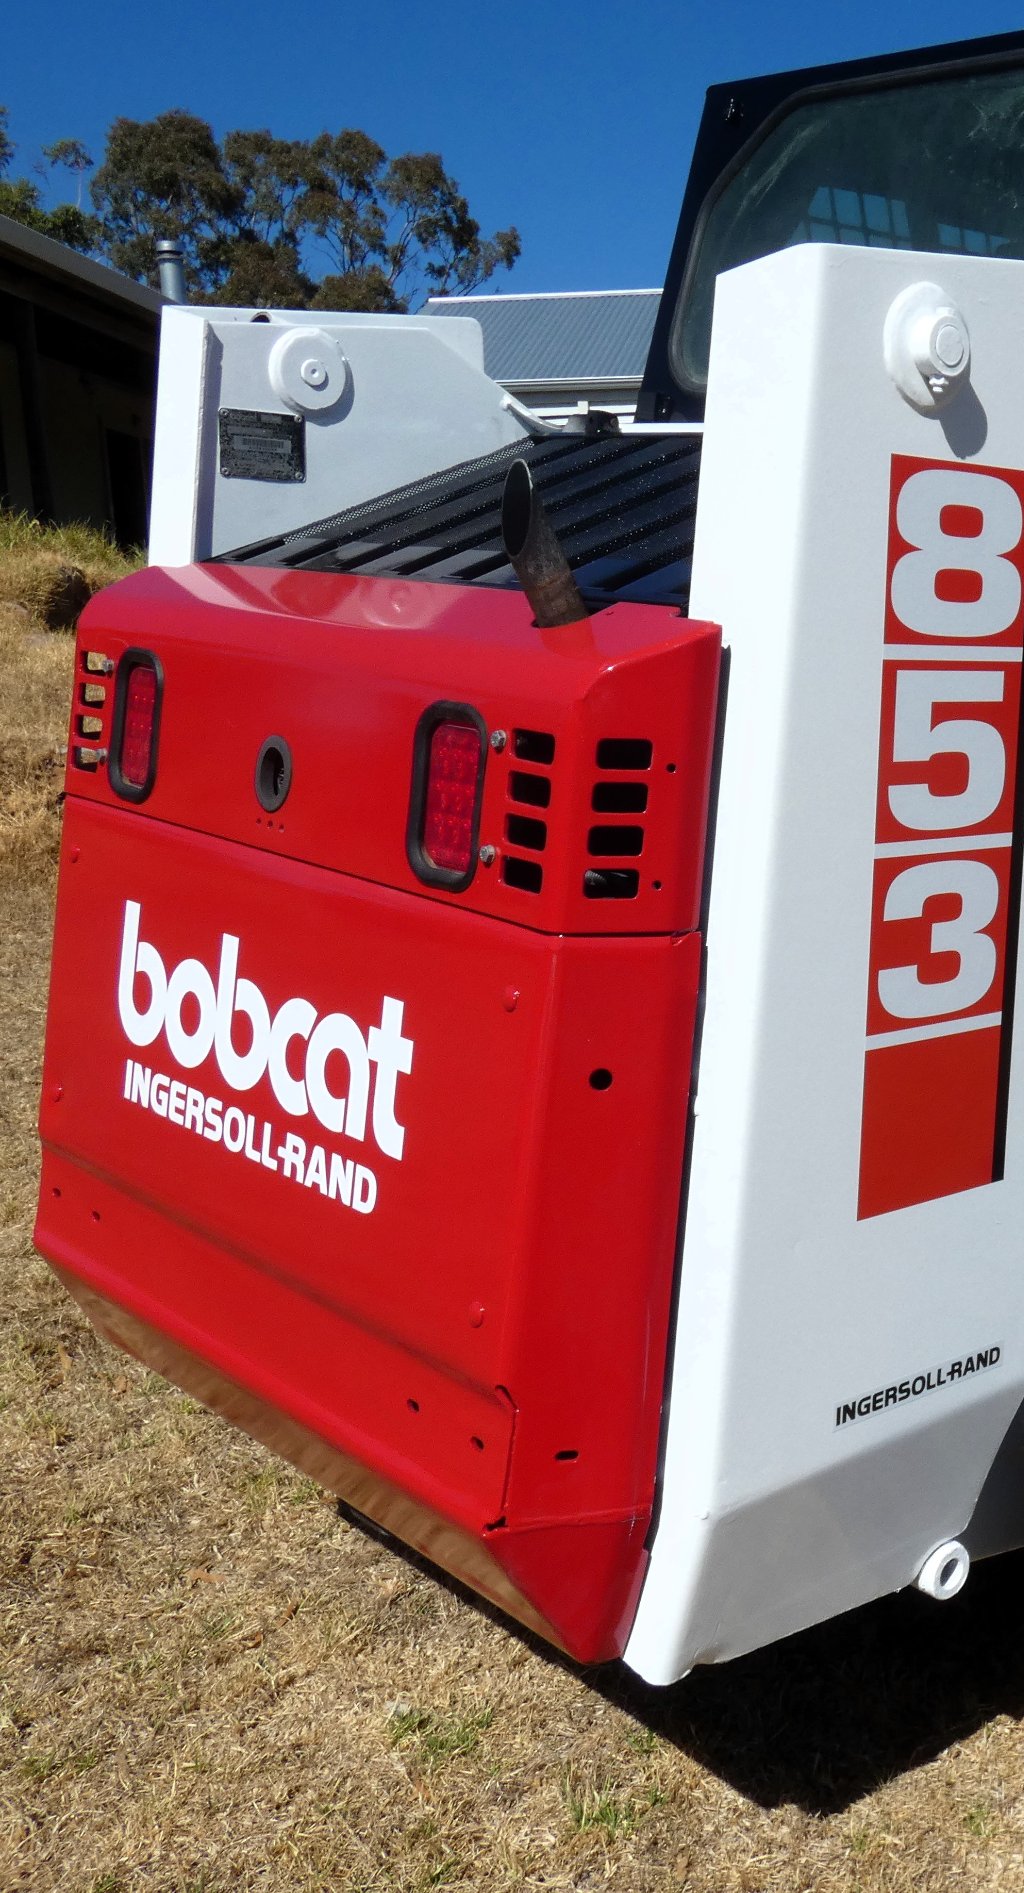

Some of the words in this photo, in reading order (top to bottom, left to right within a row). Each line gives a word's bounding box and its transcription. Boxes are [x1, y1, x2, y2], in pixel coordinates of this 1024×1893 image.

[877, 468, 1024, 1019] 853
[118, 899, 414, 1161] bobcat
[123, 1058, 378, 1215] INGERSOLL-RAND
[835, 1346, 1001, 1427] INGERSOLL-RAND
